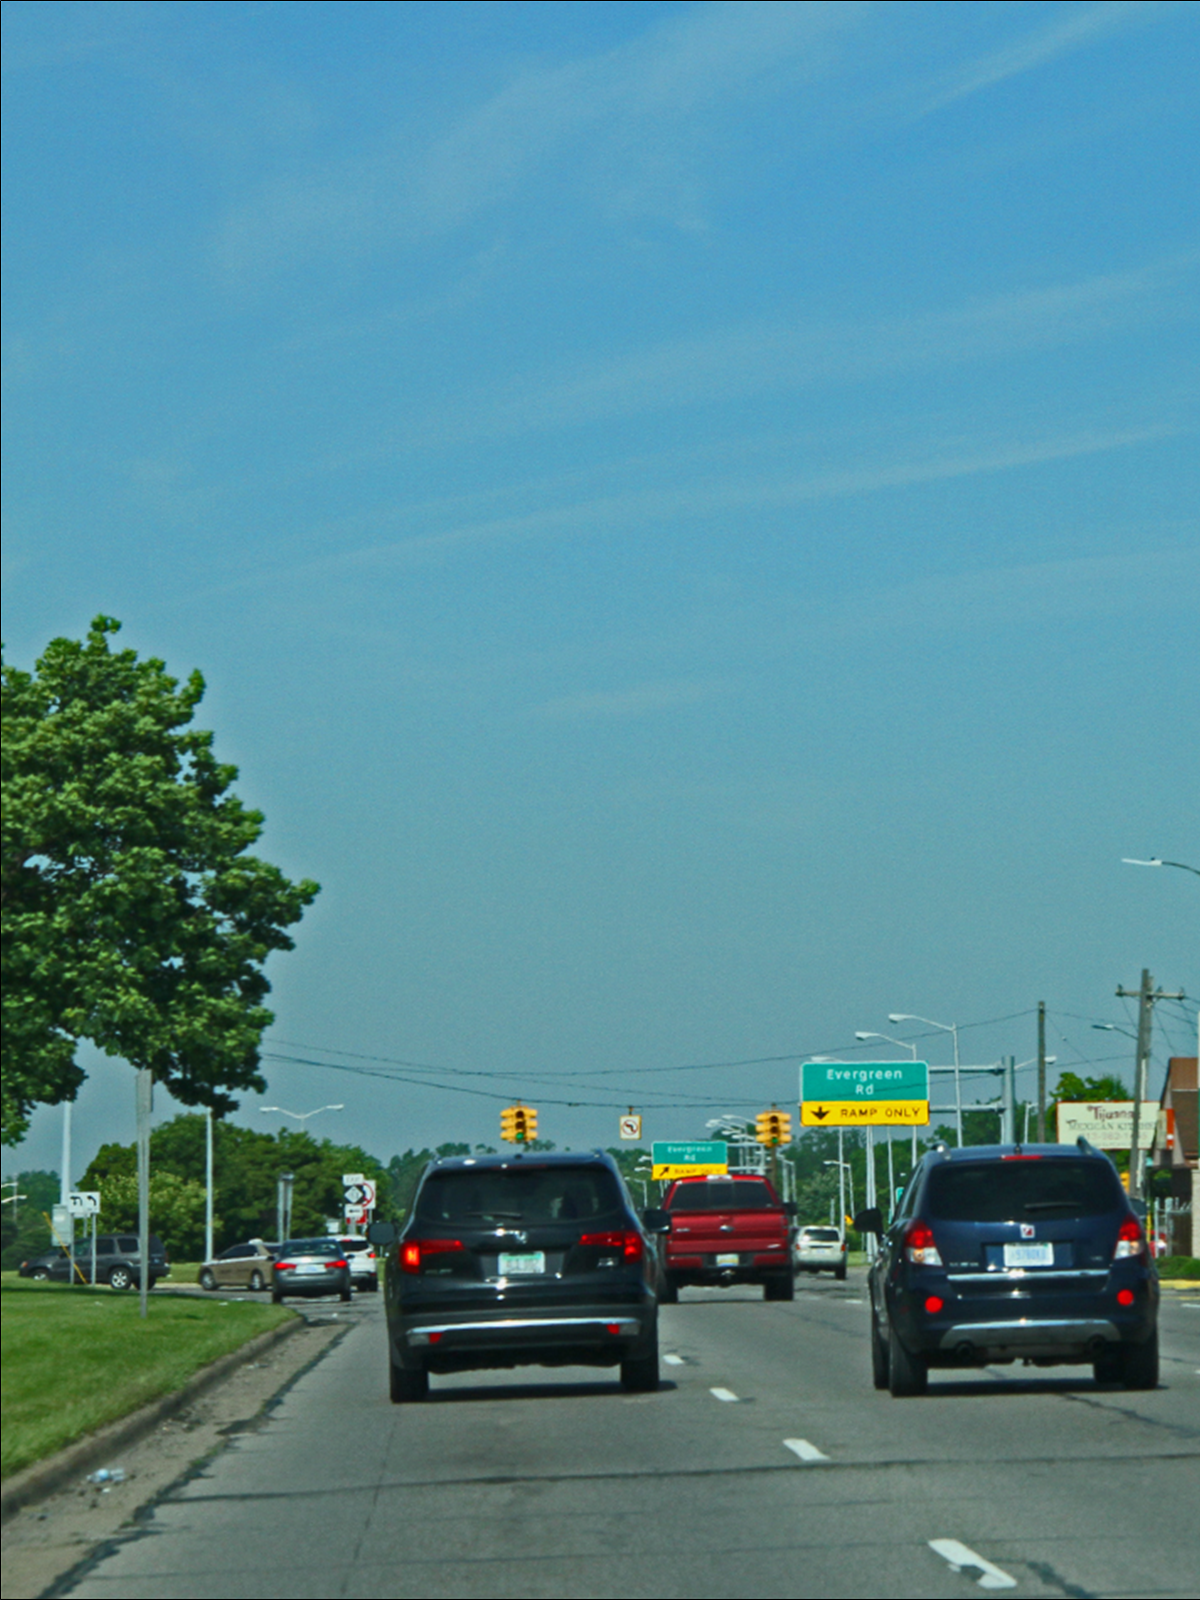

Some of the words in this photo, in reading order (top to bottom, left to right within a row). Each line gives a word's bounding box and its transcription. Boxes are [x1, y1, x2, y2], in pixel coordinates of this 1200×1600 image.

[826, 1069, 903, 1082] Evergreen
[855, 1084, 875, 1095] Rd
[840, 1108, 878, 1118] RAMP
[885, 1107, 920, 1118] ONLY
